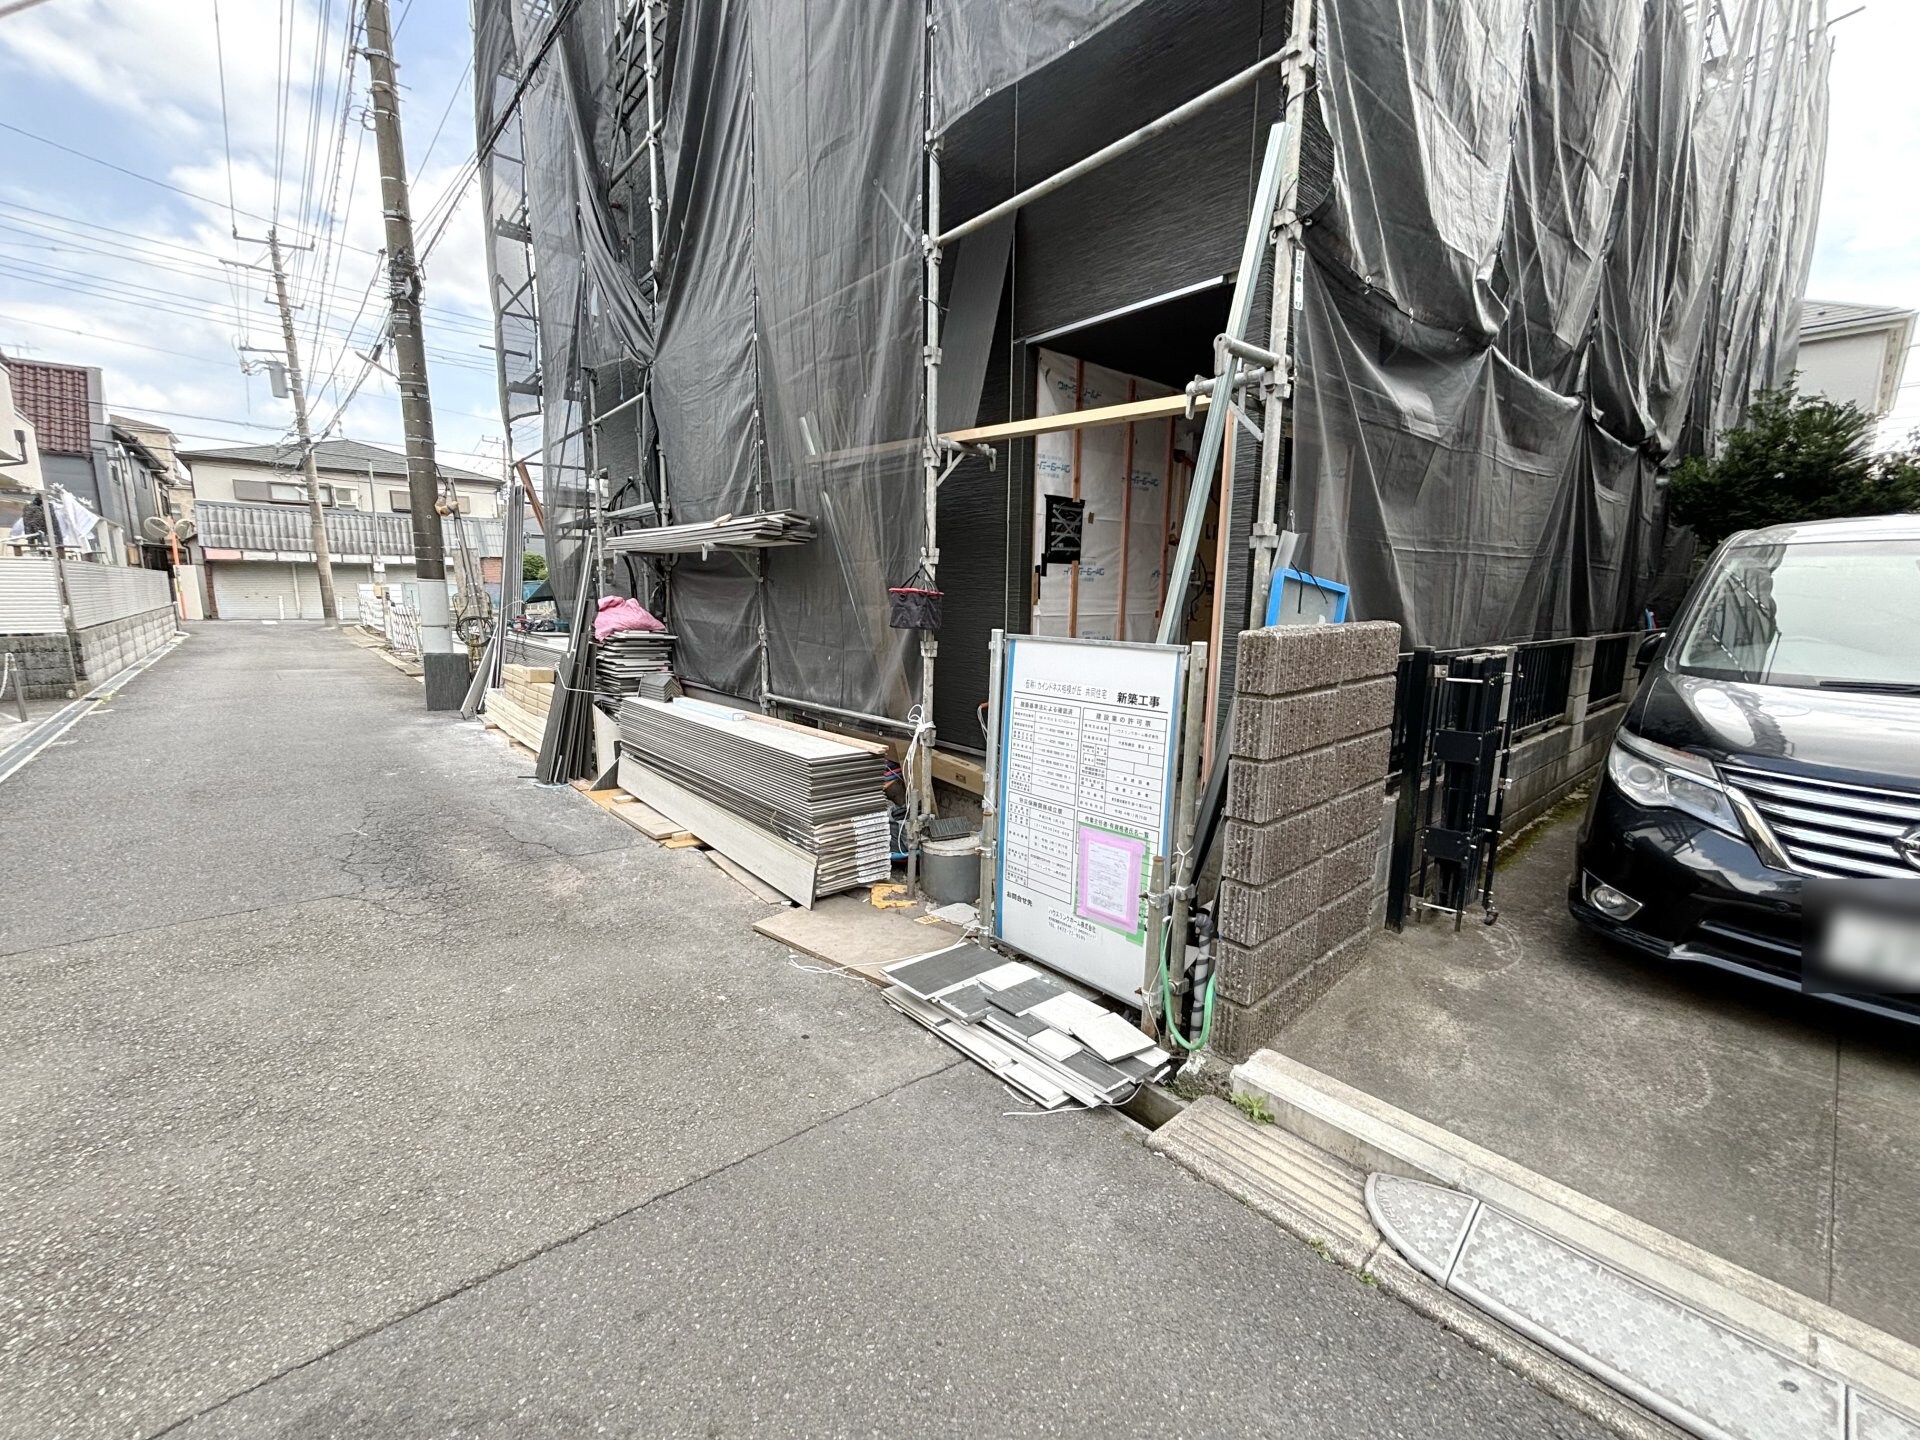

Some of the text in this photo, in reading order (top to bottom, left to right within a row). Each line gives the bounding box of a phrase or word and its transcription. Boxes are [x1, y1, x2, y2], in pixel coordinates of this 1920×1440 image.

[1117, 691, 1161, 708] 新築工事
[1006, 890, 1033, 907] お問合せ先
